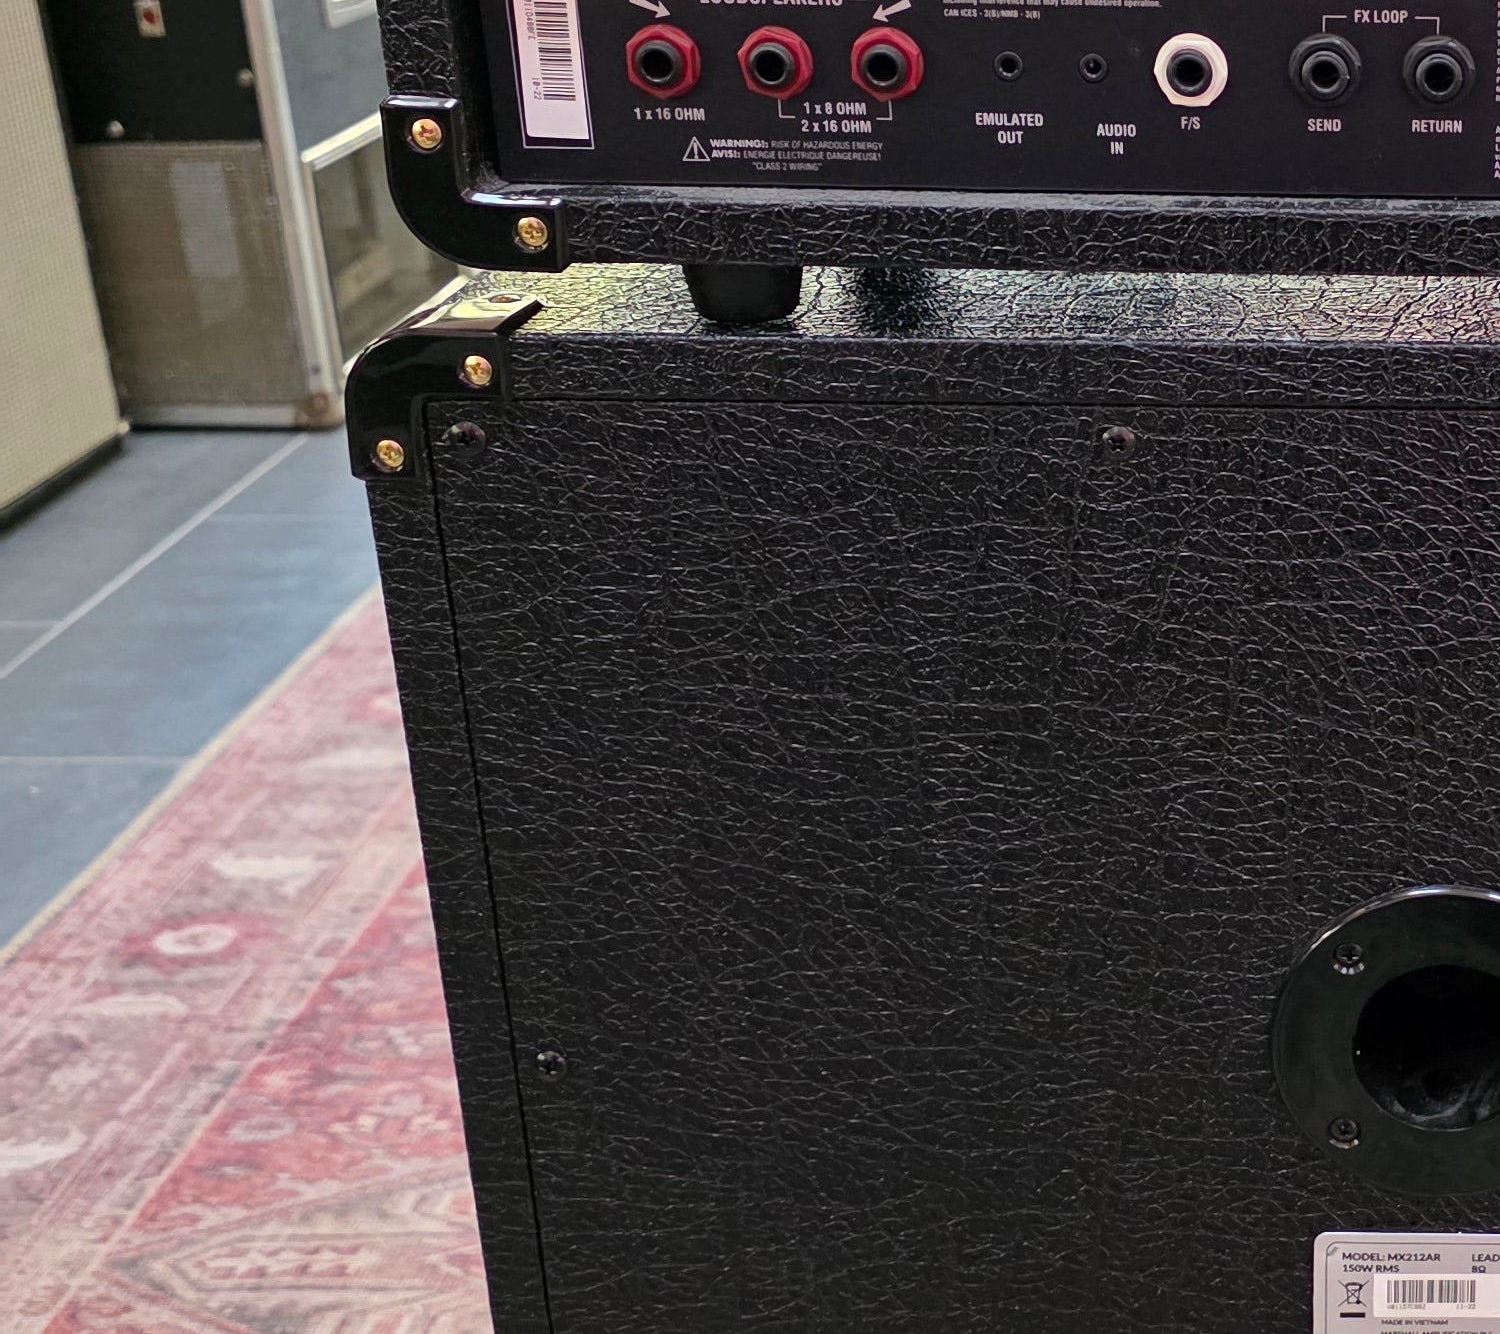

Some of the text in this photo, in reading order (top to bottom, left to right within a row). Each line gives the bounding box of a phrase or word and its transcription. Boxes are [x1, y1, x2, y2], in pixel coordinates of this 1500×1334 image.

[1354, 9, 1408, 23] FX LOOP
[658, 107, 671, 120] 16
[675, 107, 705, 121] OHM
[836, 102, 866, 115] OHM
[824, 120, 837, 133] 16
[842, 120, 871, 133] OHM
[974, 113, 1044, 127] EMULATED
[1180, 116, 1201, 130] F/S
[1307, 119, 1342, 132] SEND
[1411, 120, 1463, 133] RETURN
[1096, 123, 1137, 137] AUDIO
[771, 140, 789, 148] RISK
[997, 131, 1024, 144] OUT
[1109, 141, 1124, 155] IN
[1388, 1253, 1441, 1261] MX212AR
[1472, 1253, 1500, 1263] LEAD
[1343, 1264, 1400, 1273] 150W RMS
